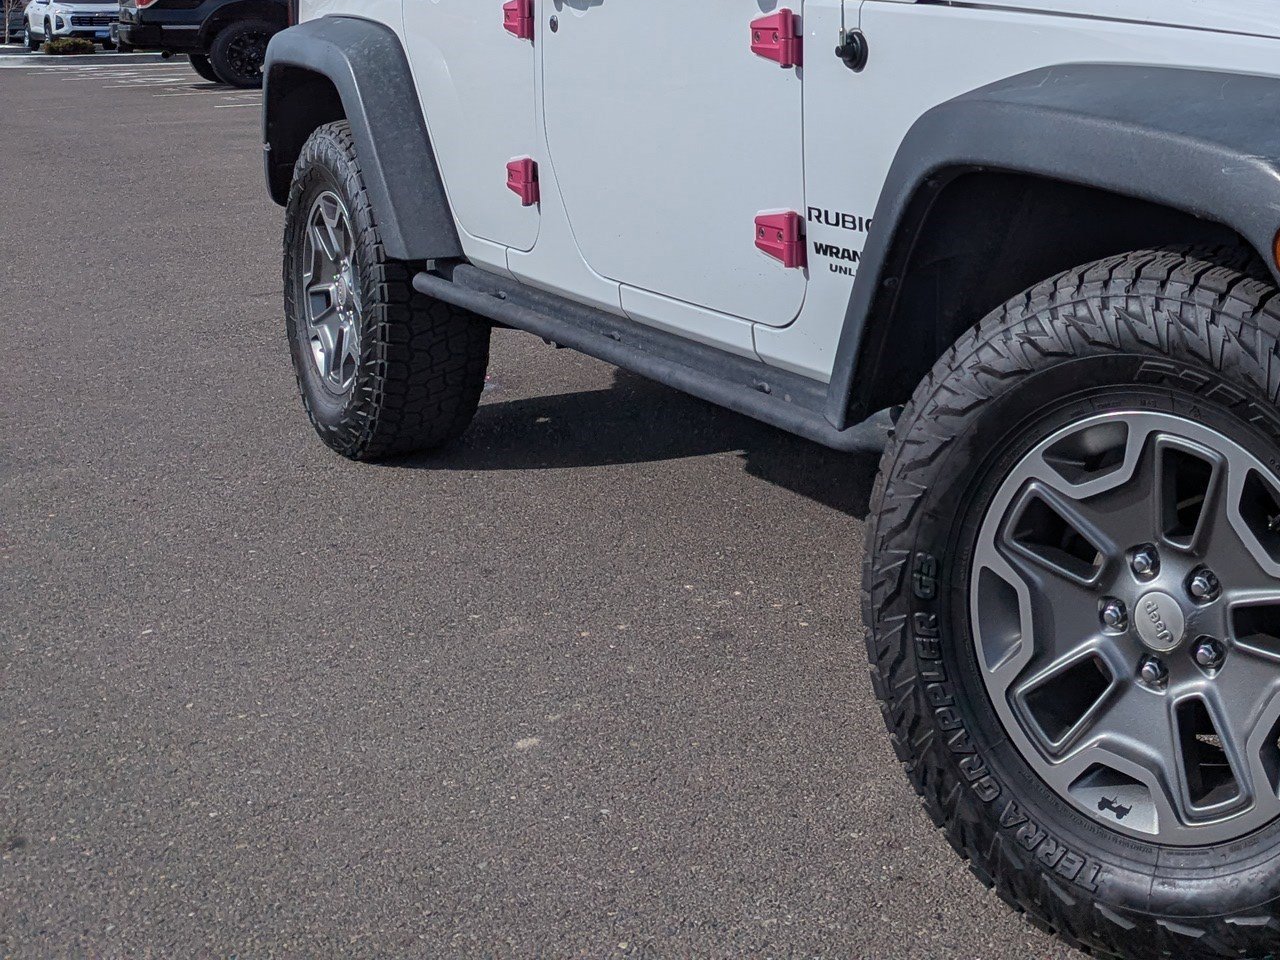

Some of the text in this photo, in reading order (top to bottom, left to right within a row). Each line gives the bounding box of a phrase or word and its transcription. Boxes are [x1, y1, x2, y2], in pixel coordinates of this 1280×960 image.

[1145, 600, 1174, 643] Jeep
[913, 611, 1001, 803] GRAPPLER
[999, 800, 1106, 891] TERRA
